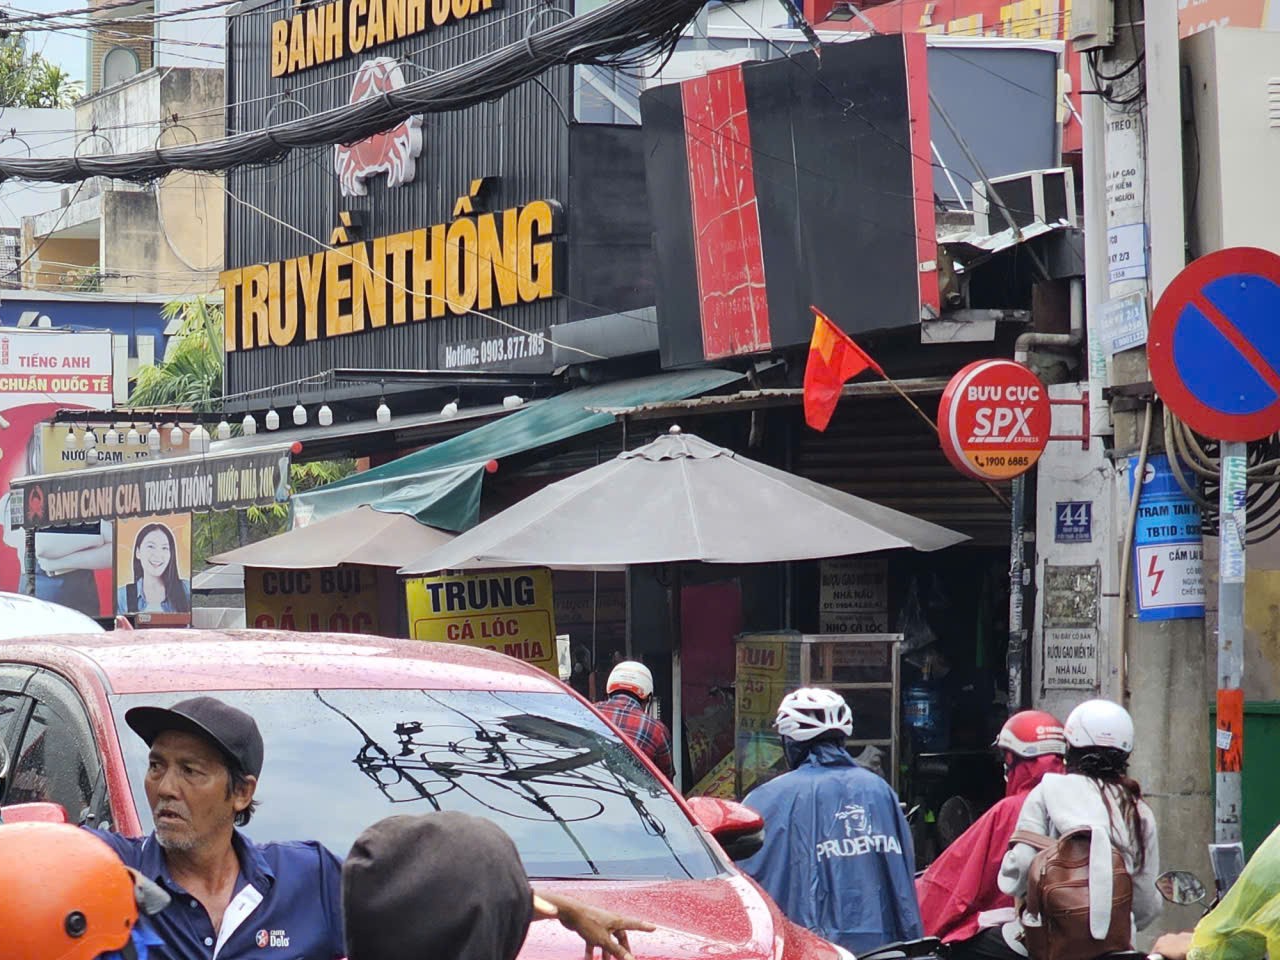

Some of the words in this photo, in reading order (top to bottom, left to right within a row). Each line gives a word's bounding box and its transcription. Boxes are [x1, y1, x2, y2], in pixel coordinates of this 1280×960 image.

[445, 343, 480, 369] Hotline:
[481, 331, 546, 364] 0903.877.185
[18, 352, 58, 368] TIẾNG
[61, 356, 91, 368] ANH
[50, 376, 89, 393] QUỐC
[967, 385, 1002, 401] BƯU
[1005, 385, 1040, 405] CỤC
[970, 407, 1034, 442] SPX
[61, 449, 88, 461] NƯỚ
[96, 452, 123, 462] CAM
[985, 457, 1006, 467] 1900
[1008, 457, 1029, 467] 6885
[48, 486, 78, 521] BÁNH
[80, 486, 113, 518] CANH
[115, 483, 141, 515] CUA
[145, 467, 179, 511] TRUYỀN
[180, 465, 213, 508] THỐNG
[217, 464, 239, 502] NƯỚC
[259, 466, 275, 498] 10K
[1059, 503, 1089, 526] 44
[1146, 525, 1178, 538] TBTID
[1169, 548, 1188, 562] CẤM
[447, 619, 475, 641] CÁ
[481, 616, 519, 638] LÓC
[504, 638, 545, 660] MÍA
[270, 934, 289, 947] Delo
